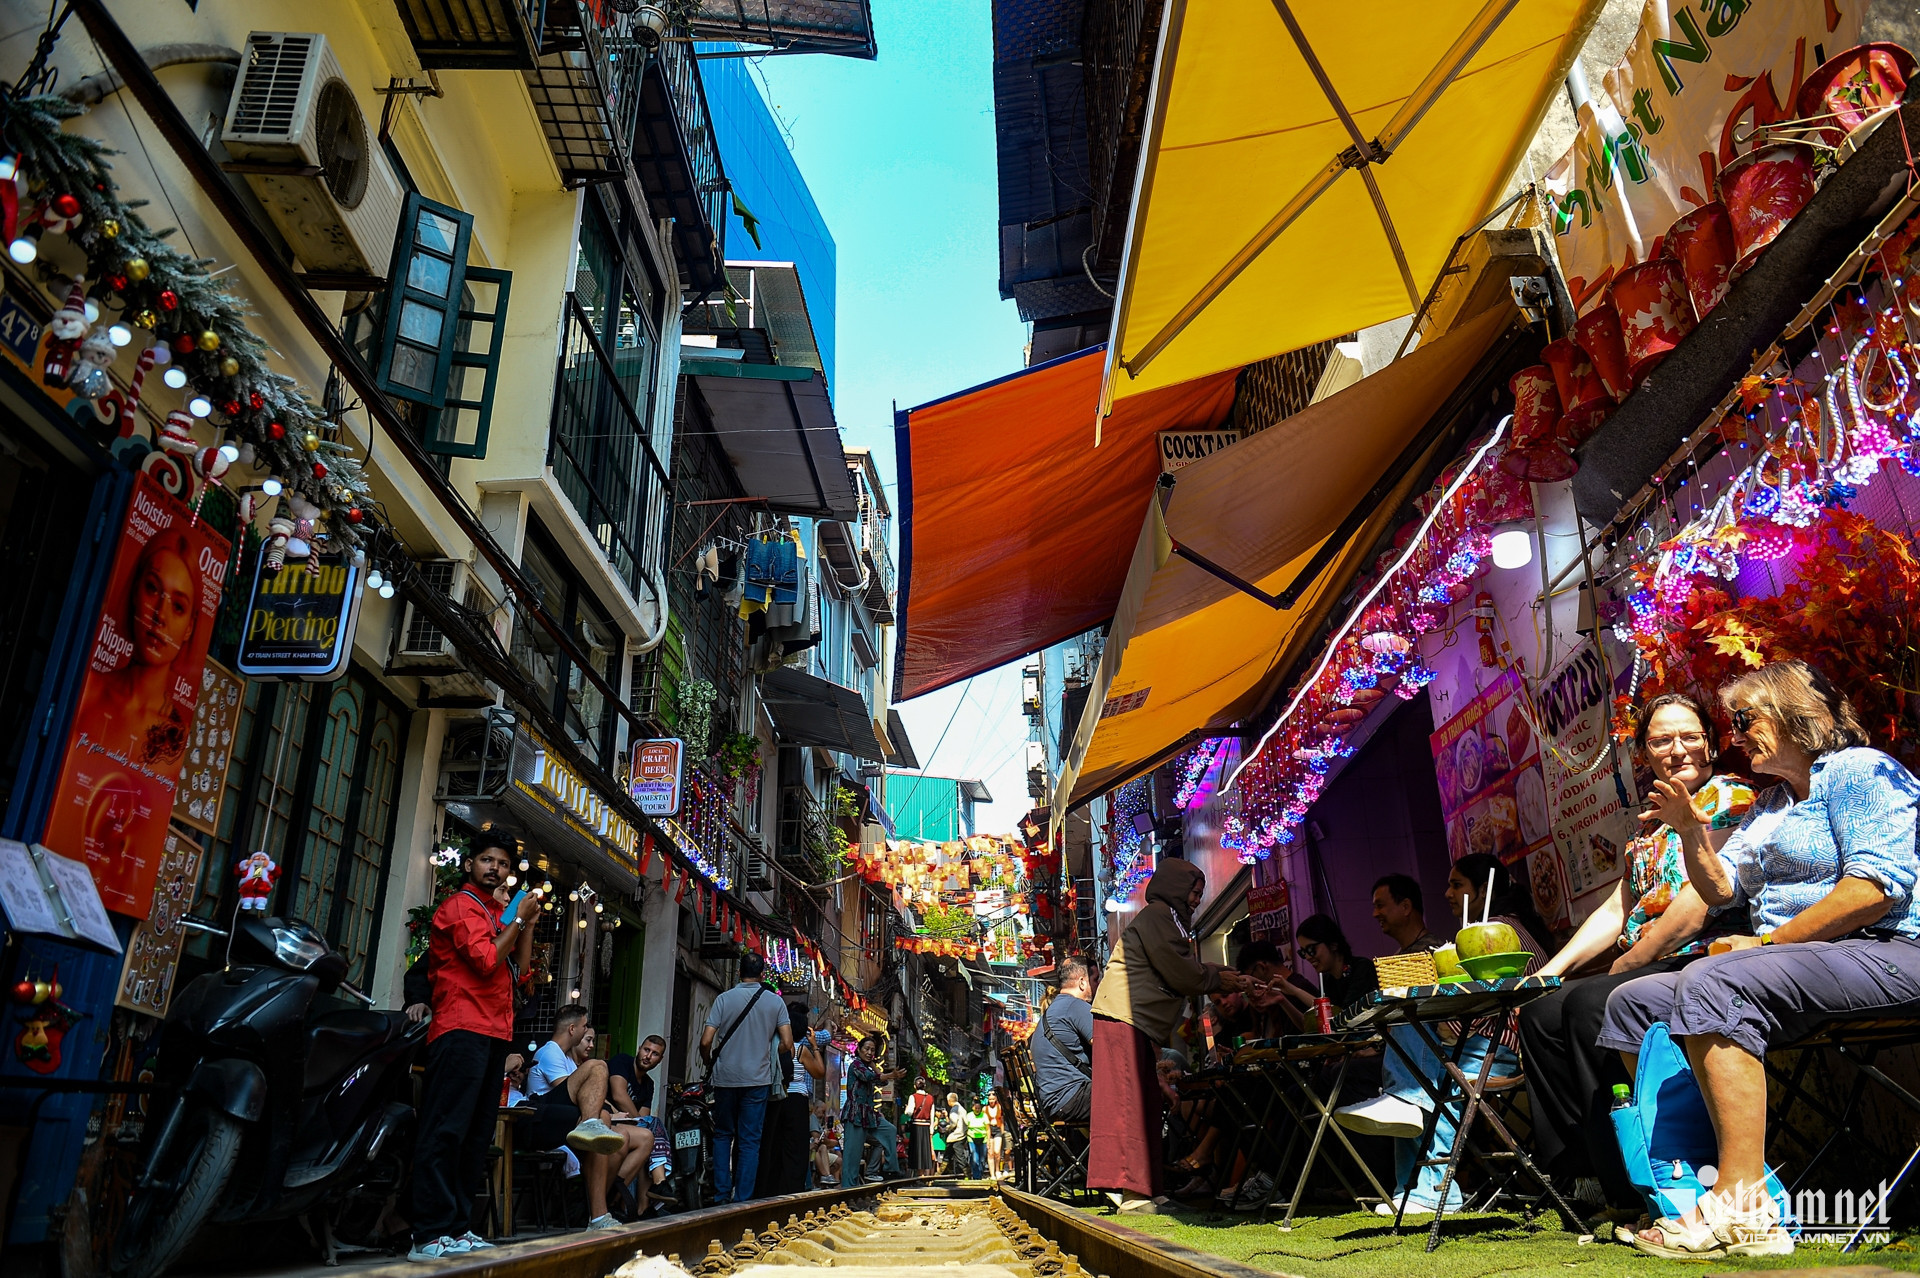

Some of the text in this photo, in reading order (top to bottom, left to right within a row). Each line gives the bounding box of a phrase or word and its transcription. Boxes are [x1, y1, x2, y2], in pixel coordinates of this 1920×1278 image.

[199, 546, 229, 584] Oral
[248, 608, 338, 650] Piercing
[174, 675, 193, 698] Lips
[1536, 648, 1611, 738] COCKTAI
[1463, 701, 1484, 727] TRACK
[1570, 735, 1597, 757] COCA
[642, 754, 669, 763] CRAFT
[644, 766, 667, 774] BEER
[634, 794, 670, 802] HOMESTAY
[1558, 780, 1591, 802] VODKA
[532, 750, 603, 831] KUNIAN
[598, 804, 640, 862] HOME
[644, 803, 667, 811] TOURS
[1561, 793, 1597, 820] MOJITO
[1570, 812, 1599, 835] VIRGIN
[1599, 792, 1632, 818] MOJIO
